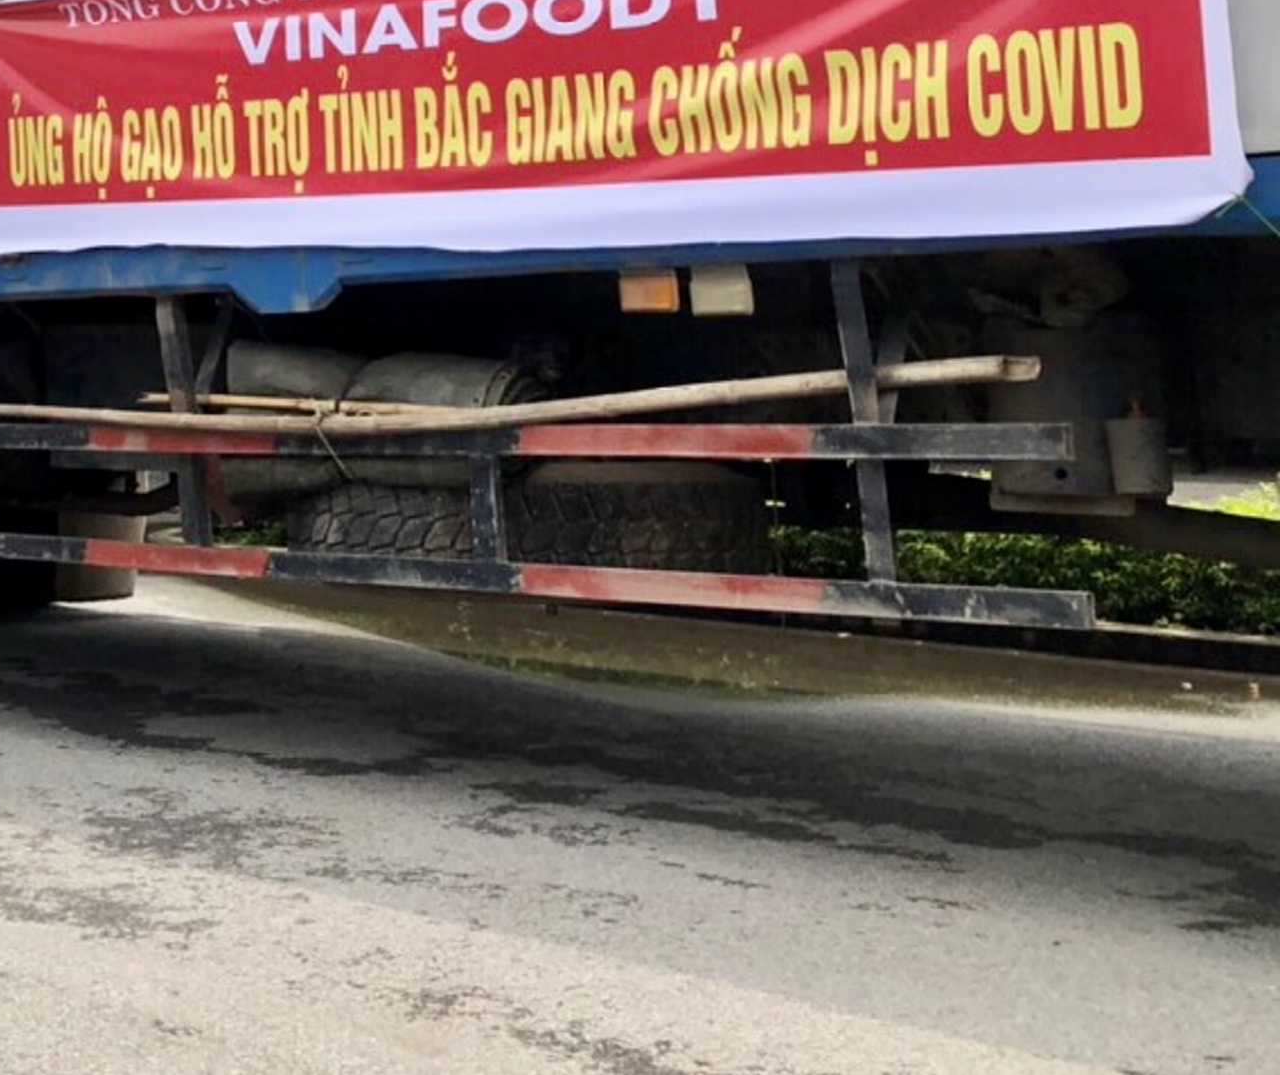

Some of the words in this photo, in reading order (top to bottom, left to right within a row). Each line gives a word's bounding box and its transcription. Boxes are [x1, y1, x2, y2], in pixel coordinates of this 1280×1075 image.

[8, 93, 65, 188] ỦNG
[73, 96, 113, 200] HỘ
[120, 105, 180, 199] GẠO
[192, 74, 237, 180] HỖ
[245, 93, 310, 195] TRỢ
[318, 65, 404, 175] TỈNH
[416, 52, 493, 170] BẮC
[505, 69, 637, 165] GIANG
[648, 26, 811, 156] CHỐNG
[825, 39, 950, 166] DỊCH
[966, 21, 1144, 138] COVID
